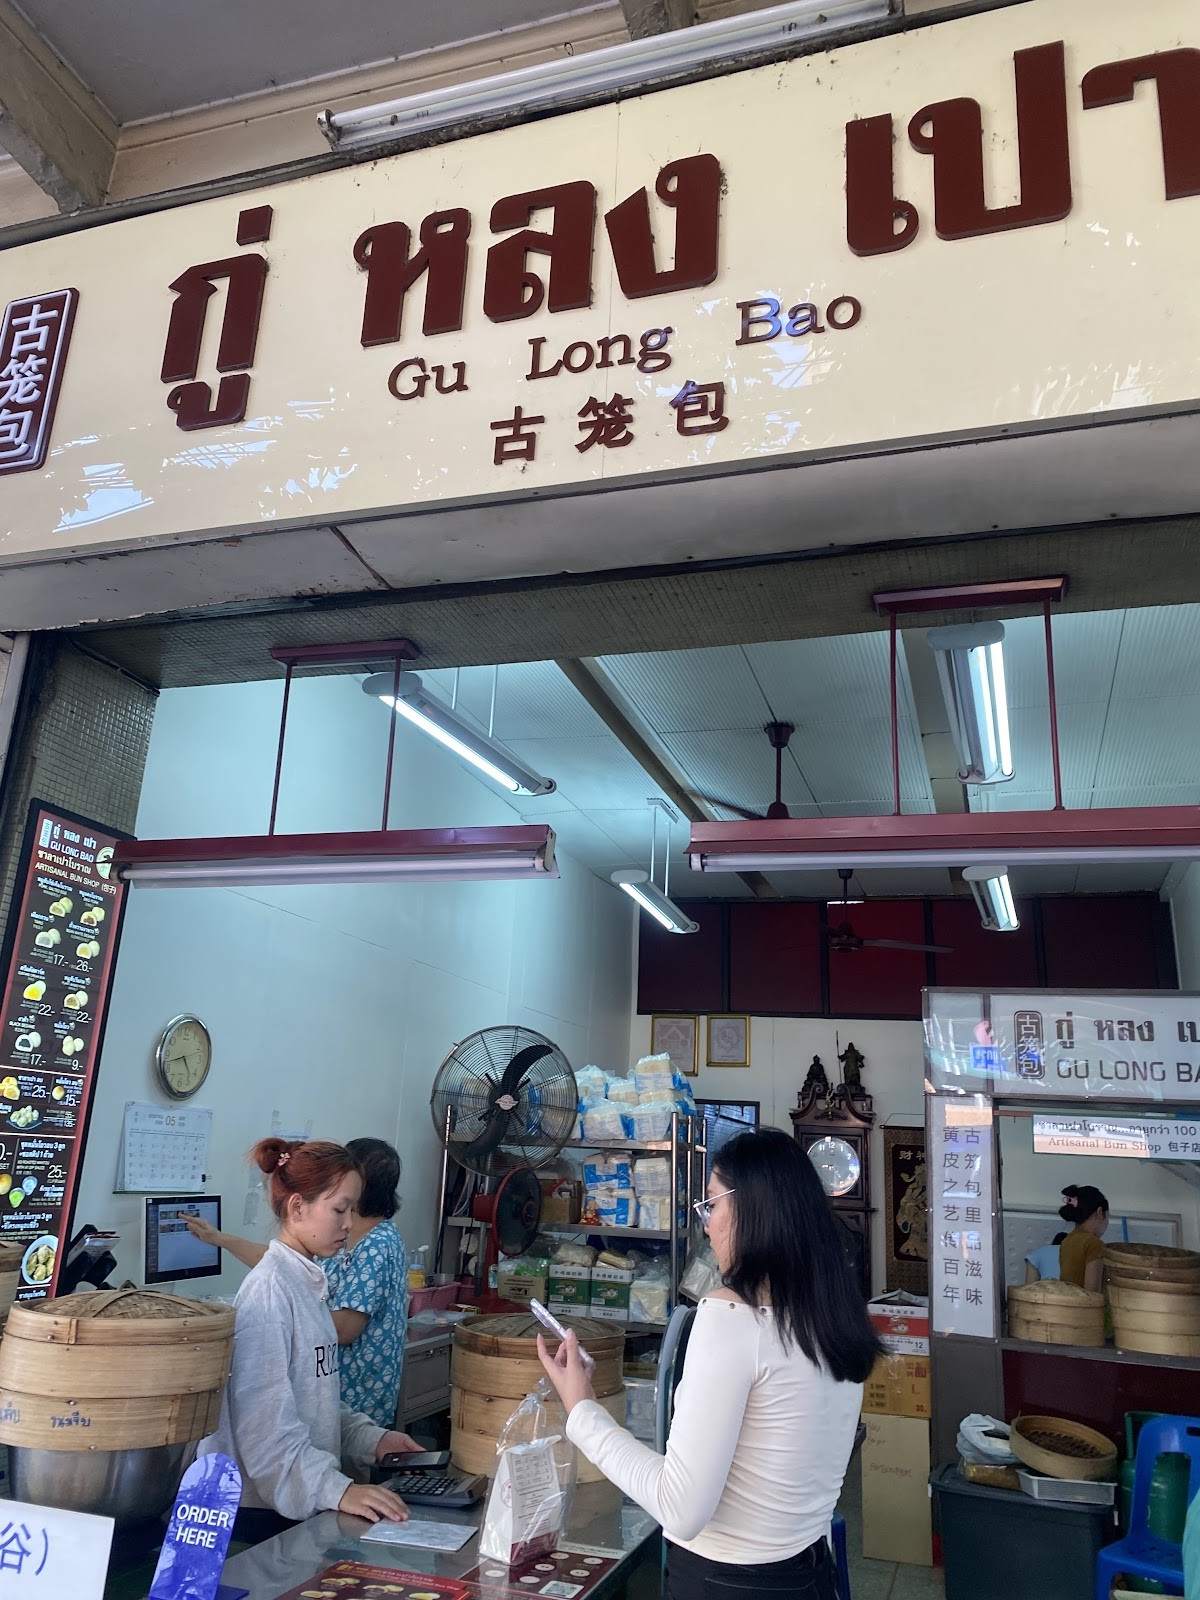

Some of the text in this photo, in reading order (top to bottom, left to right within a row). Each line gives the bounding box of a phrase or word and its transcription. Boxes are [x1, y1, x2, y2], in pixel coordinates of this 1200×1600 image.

[161, 204, 274, 431] กู่
[352, 152, 723, 348] หลง
[388, 294, 862, 400] Gu Long Bao
[490, 380, 730, 466] 古笼包
[50, 841, 94, 863] GU LONG BAO
[35, 862, 69, 879] ARTISANAL
[69, 872, 82, 884] BUN
[83, 877, 100, 888] SHOP
[1055, 1011, 1075, 1049] กู่
[1093, 1019, 1155, 1042] หลง
[1057, 1058, 1089, 1079] GU
[1100, 1059, 1166, 1082] LONG
[1174, 1125, 1197, 1136] 100
[1049, 1137, 1162, 1154] Artisanal Bun Shop
[176, 1504, 230, 1528] ORDER
[175, 1526, 218, 1549] HERE
